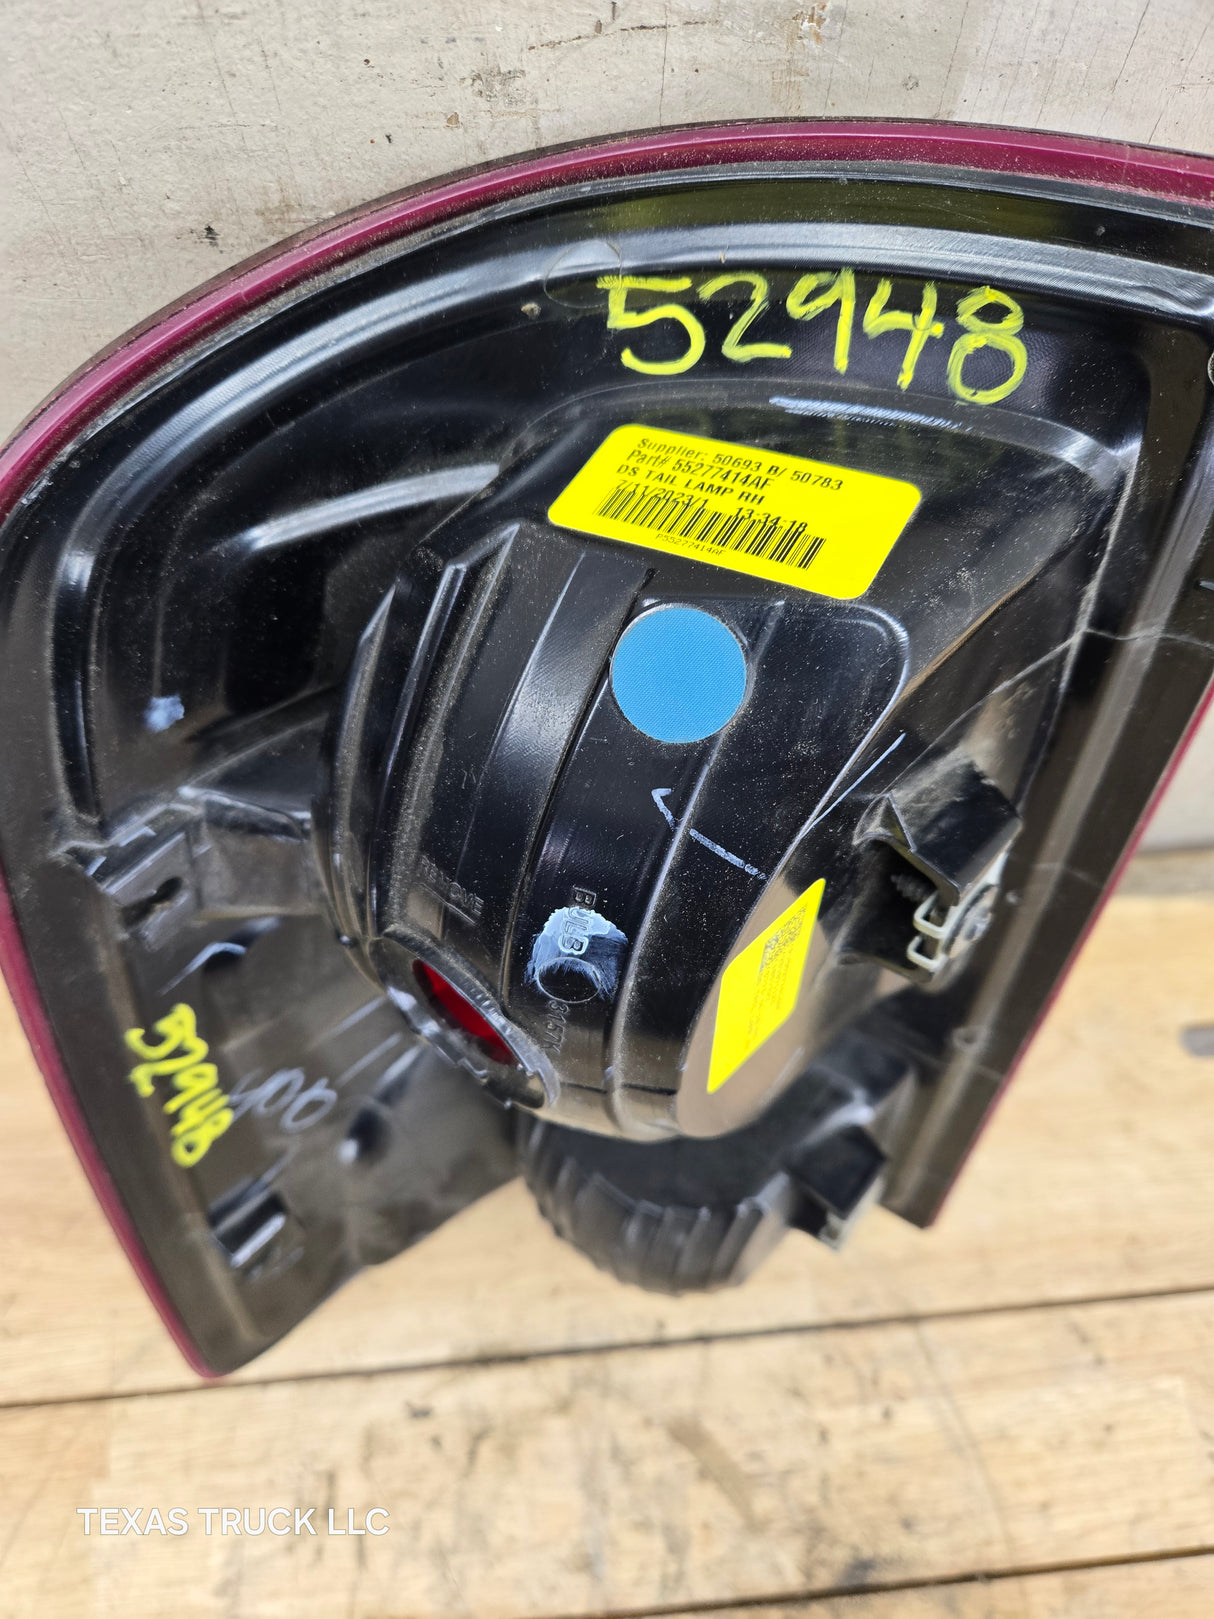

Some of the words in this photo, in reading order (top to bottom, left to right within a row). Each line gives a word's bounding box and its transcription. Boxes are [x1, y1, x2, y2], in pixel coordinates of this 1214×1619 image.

[597, 267, 1028, 405] 52948
[616, 464, 640, 477] DS
[645, 469, 677, 486] TAIL
[684, 479, 734, 497] LAMP
[737, 491, 765, 506] RH
[626, 449, 672, 468] Part#
[672, 459, 775, 491] 55277414AF
[637, 438, 708, 461] Supplier:
[712, 453, 762, 472] 50693
[766, 464, 787, 478] B/
[790, 470, 843, 491] 50783
[655, 533, 726, 556] P55277414AF
[561, 884, 597, 953] BULB
[124, 1003, 234, 1168] 52948
